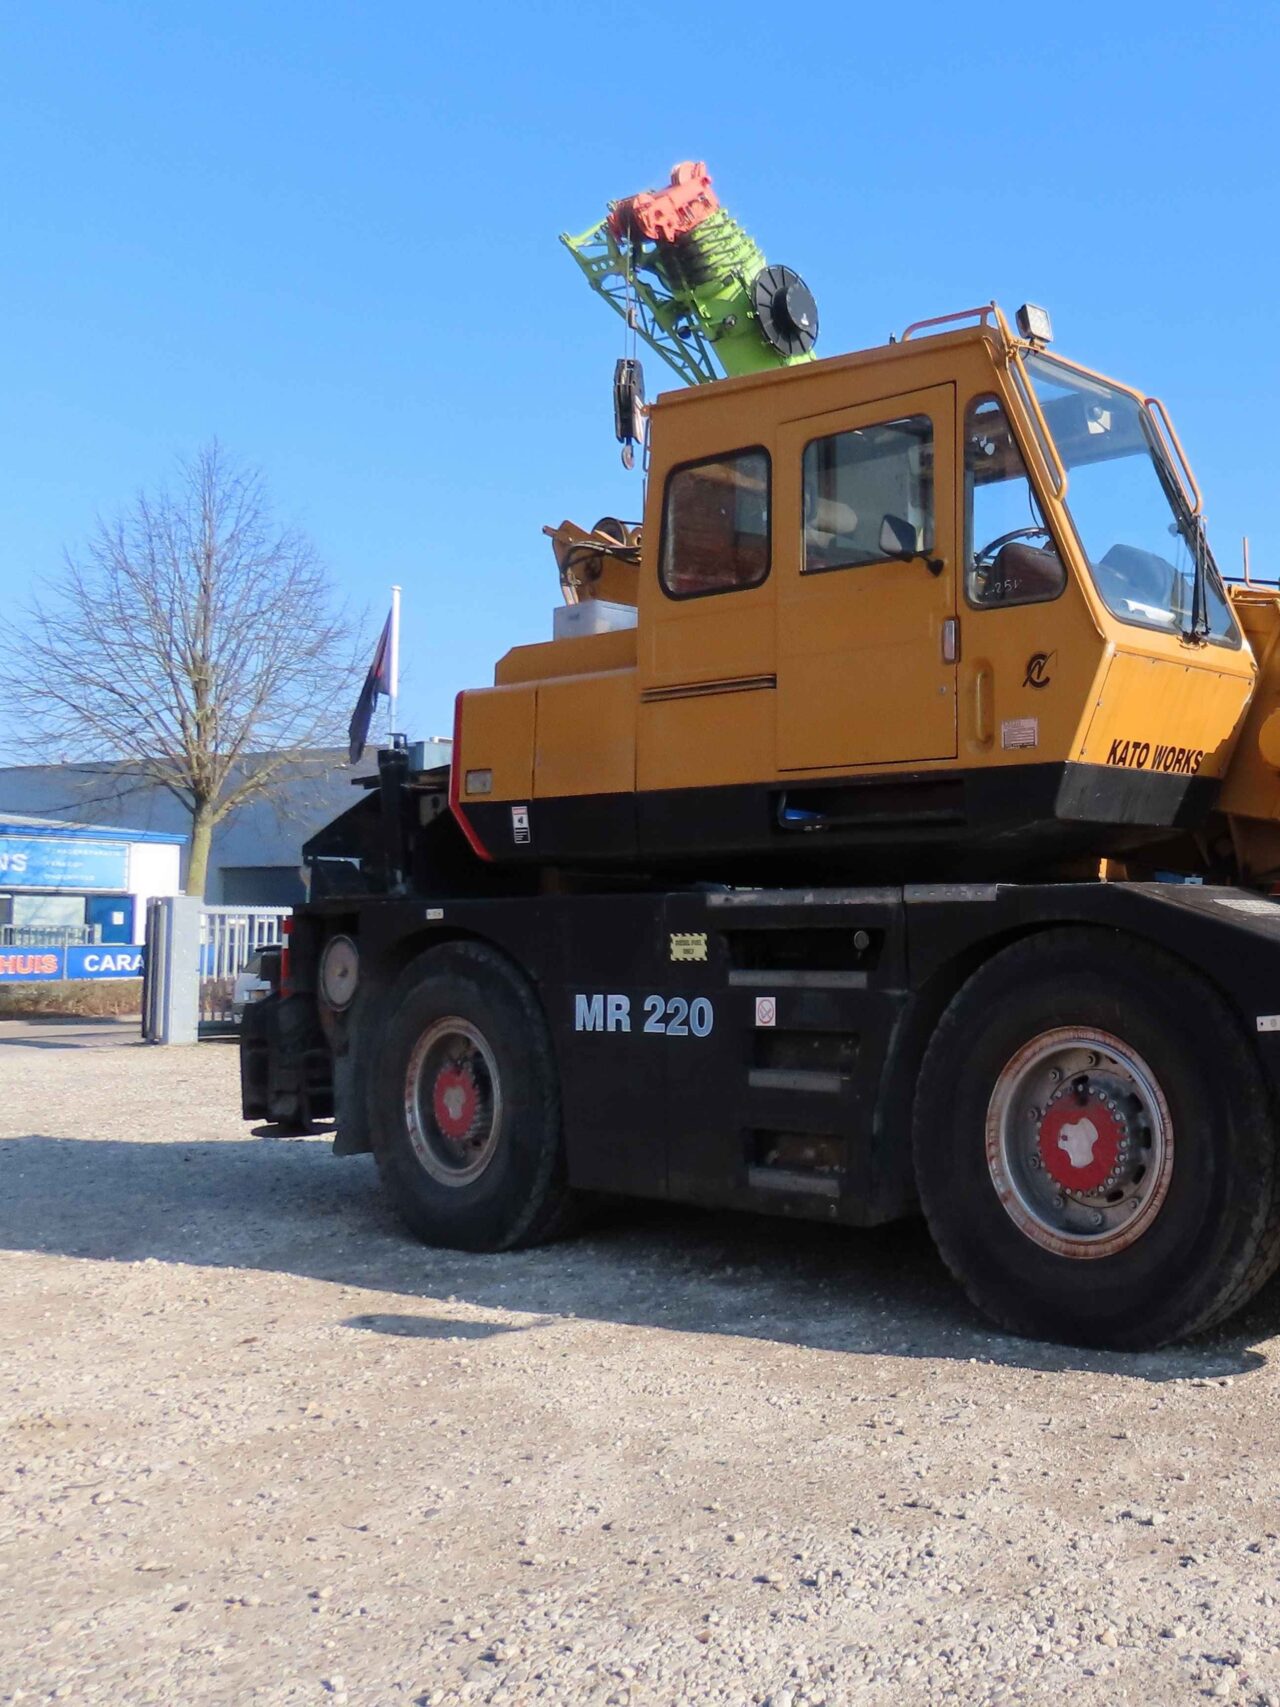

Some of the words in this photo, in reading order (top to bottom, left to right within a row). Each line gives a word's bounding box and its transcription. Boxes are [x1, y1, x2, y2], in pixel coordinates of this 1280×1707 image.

[1106, 739, 1150, 769] KATO
[1151, 745, 1204, 774] WORKS
[575, 994, 632, 1032] MR
[643, 994, 714, 1038] 220
